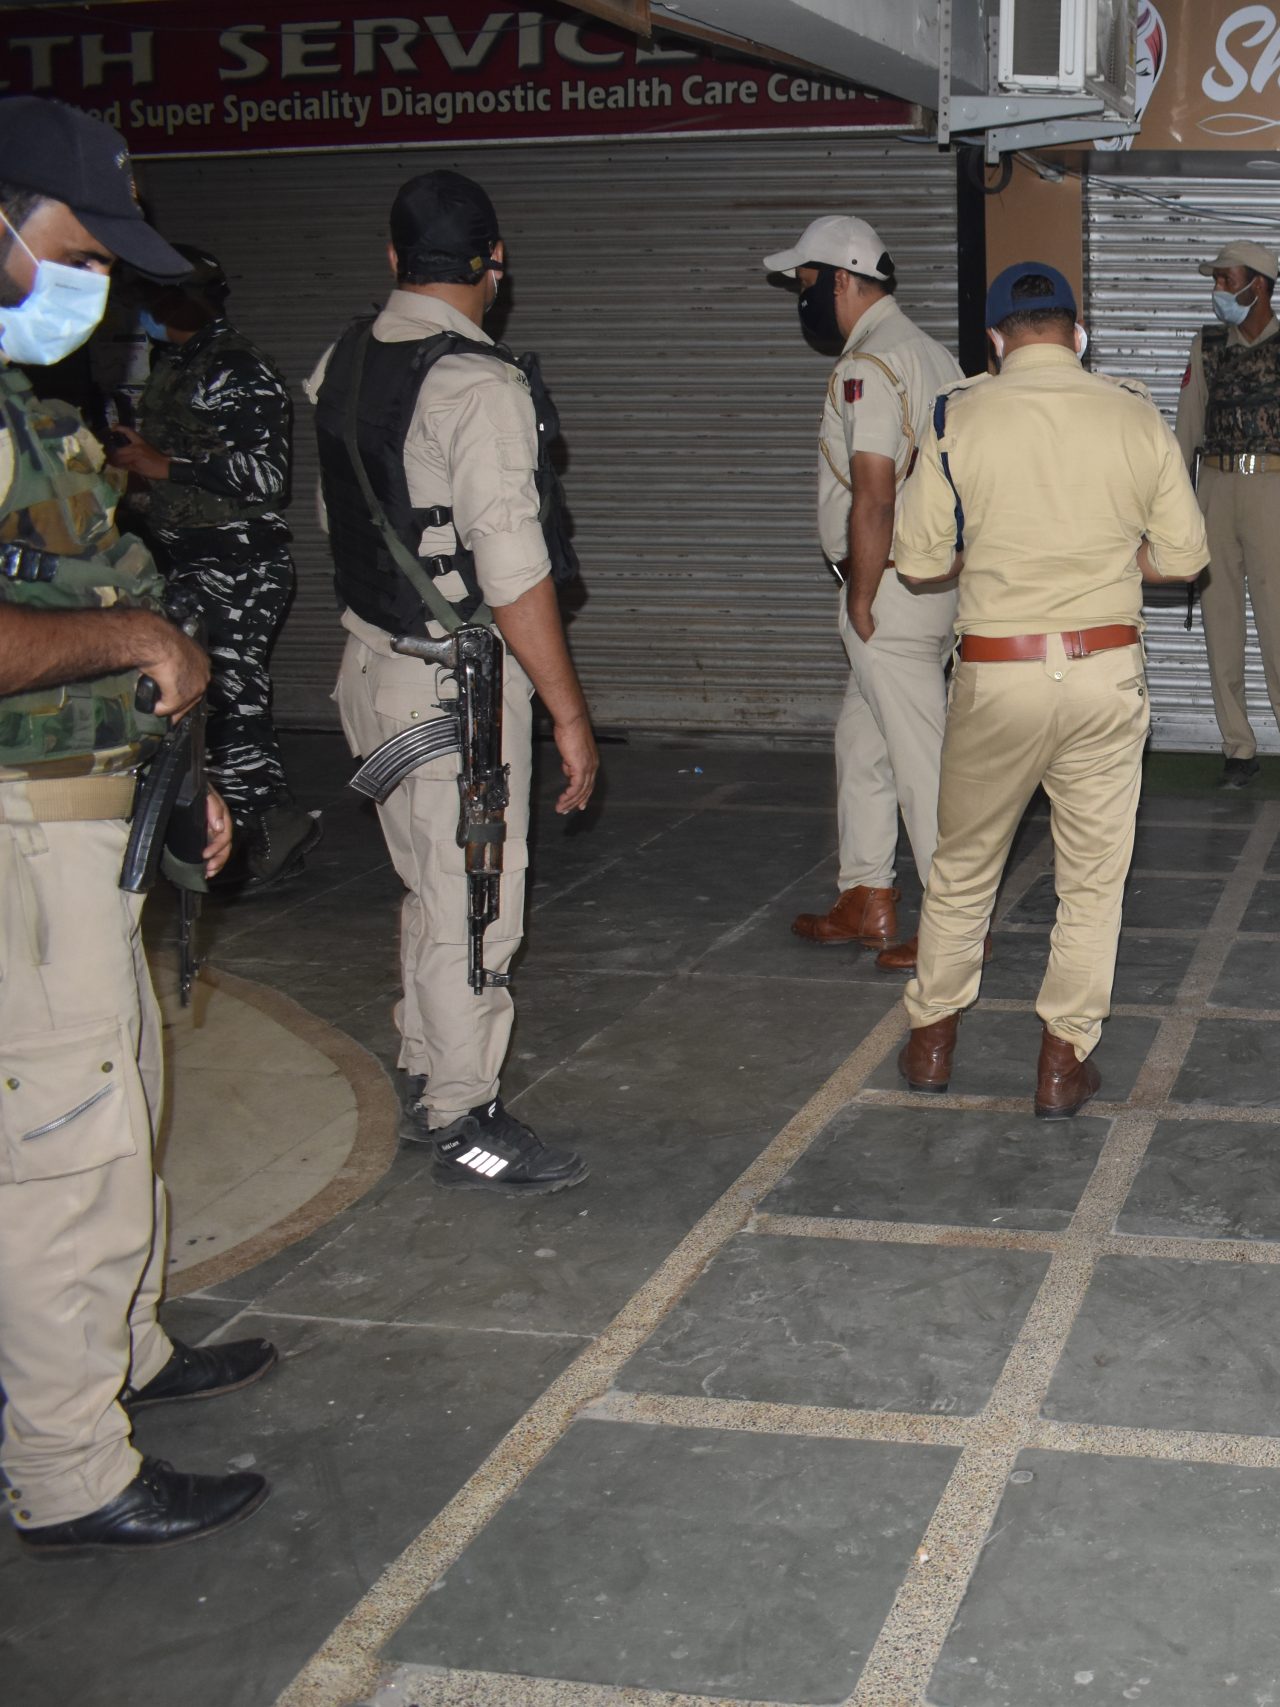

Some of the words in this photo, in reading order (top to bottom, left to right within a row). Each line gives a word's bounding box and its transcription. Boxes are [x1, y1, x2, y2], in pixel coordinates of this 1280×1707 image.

[0, 31, 155, 89] TH
[217, 12, 698, 81] SERVIC
[131, 100, 215, 135] Super
[224, 89, 371, 132] Speciality
[381, 81, 551, 124] Diagnostic
[561, 77, 672, 110] Health
[682, 73, 757, 106] Care
